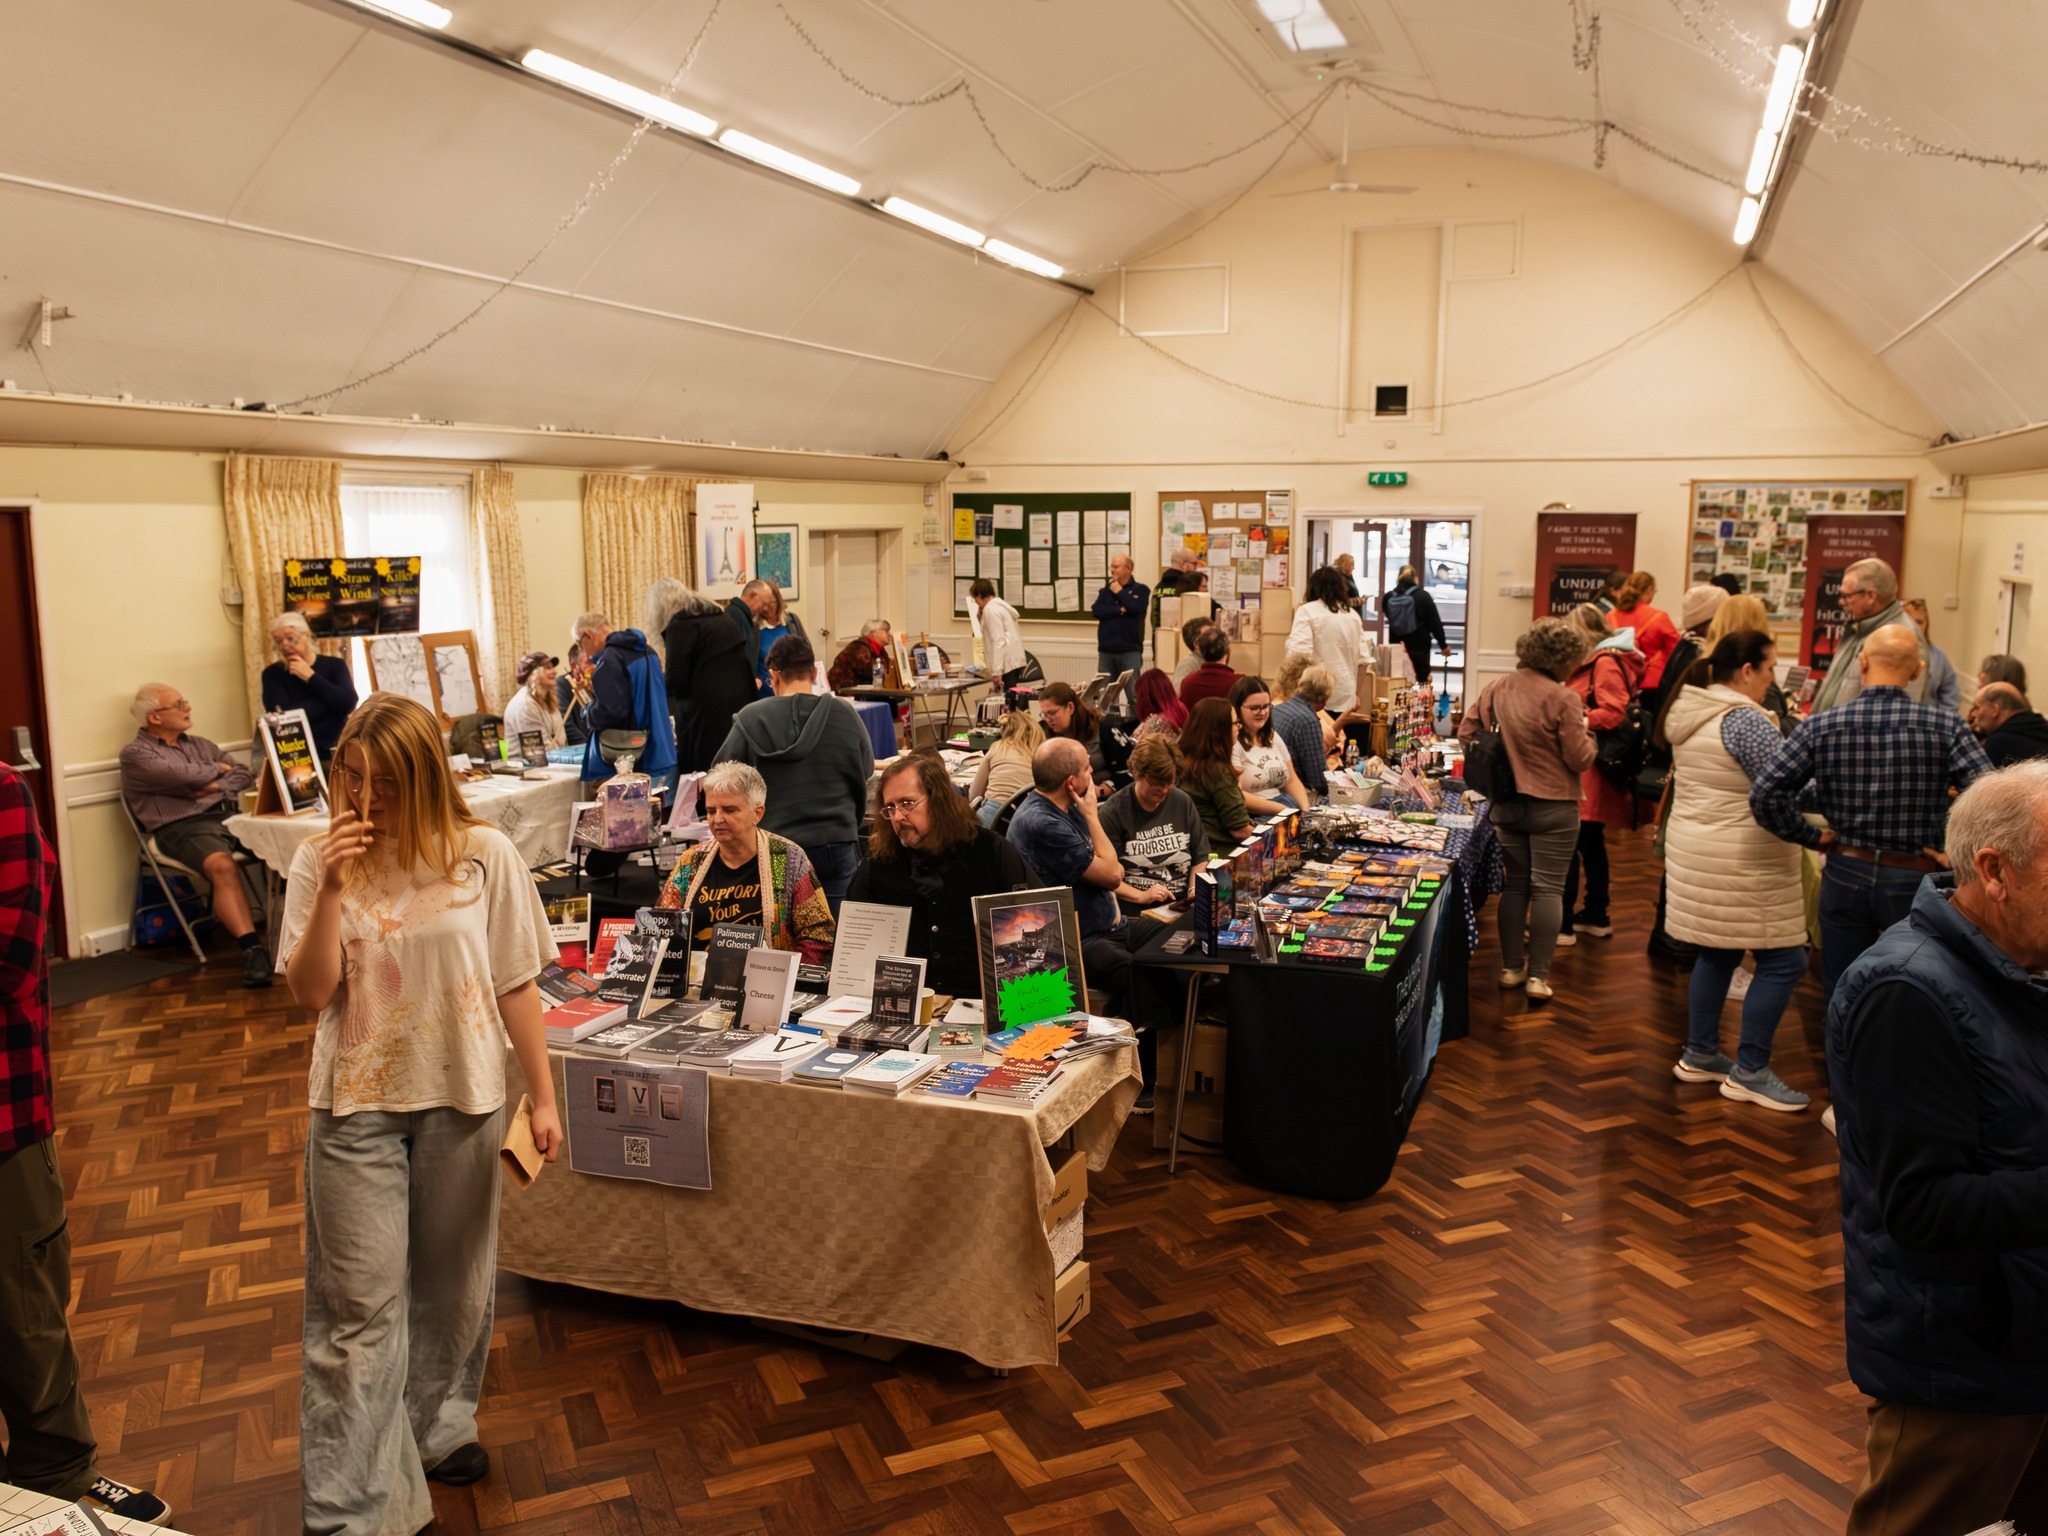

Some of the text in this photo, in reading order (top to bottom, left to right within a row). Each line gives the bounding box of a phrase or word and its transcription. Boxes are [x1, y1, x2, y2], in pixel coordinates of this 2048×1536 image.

[289, 574, 329, 587] Murder
[340, 575, 372, 584] Straw
[1560, 578, 1605, 589] UNDER
[340, 587, 372, 599] Wind
[276, 737, 306, 754] Murder
[1136, 823, 1174, 840] ALWAYS BE
[1131, 836, 1182, 855] YOURSELF
[699, 884, 761, 903] SUPPORT
[708, 902, 742, 922] YOUR
[641, 915, 669, 925] Happy
[642, 927, 674, 936] Endings
[717, 928, 755, 940] Palimpsest
[717, 939, 751, 949] of Ghosts
[611, 970, 646, 982] Overrated
[750, 990, 775, 1000] Cheese
[773, 1036, 817, 1052] V
[1002, 1065, 1048, 1074] Notebook
[632, 1086, 647, 1104] V
